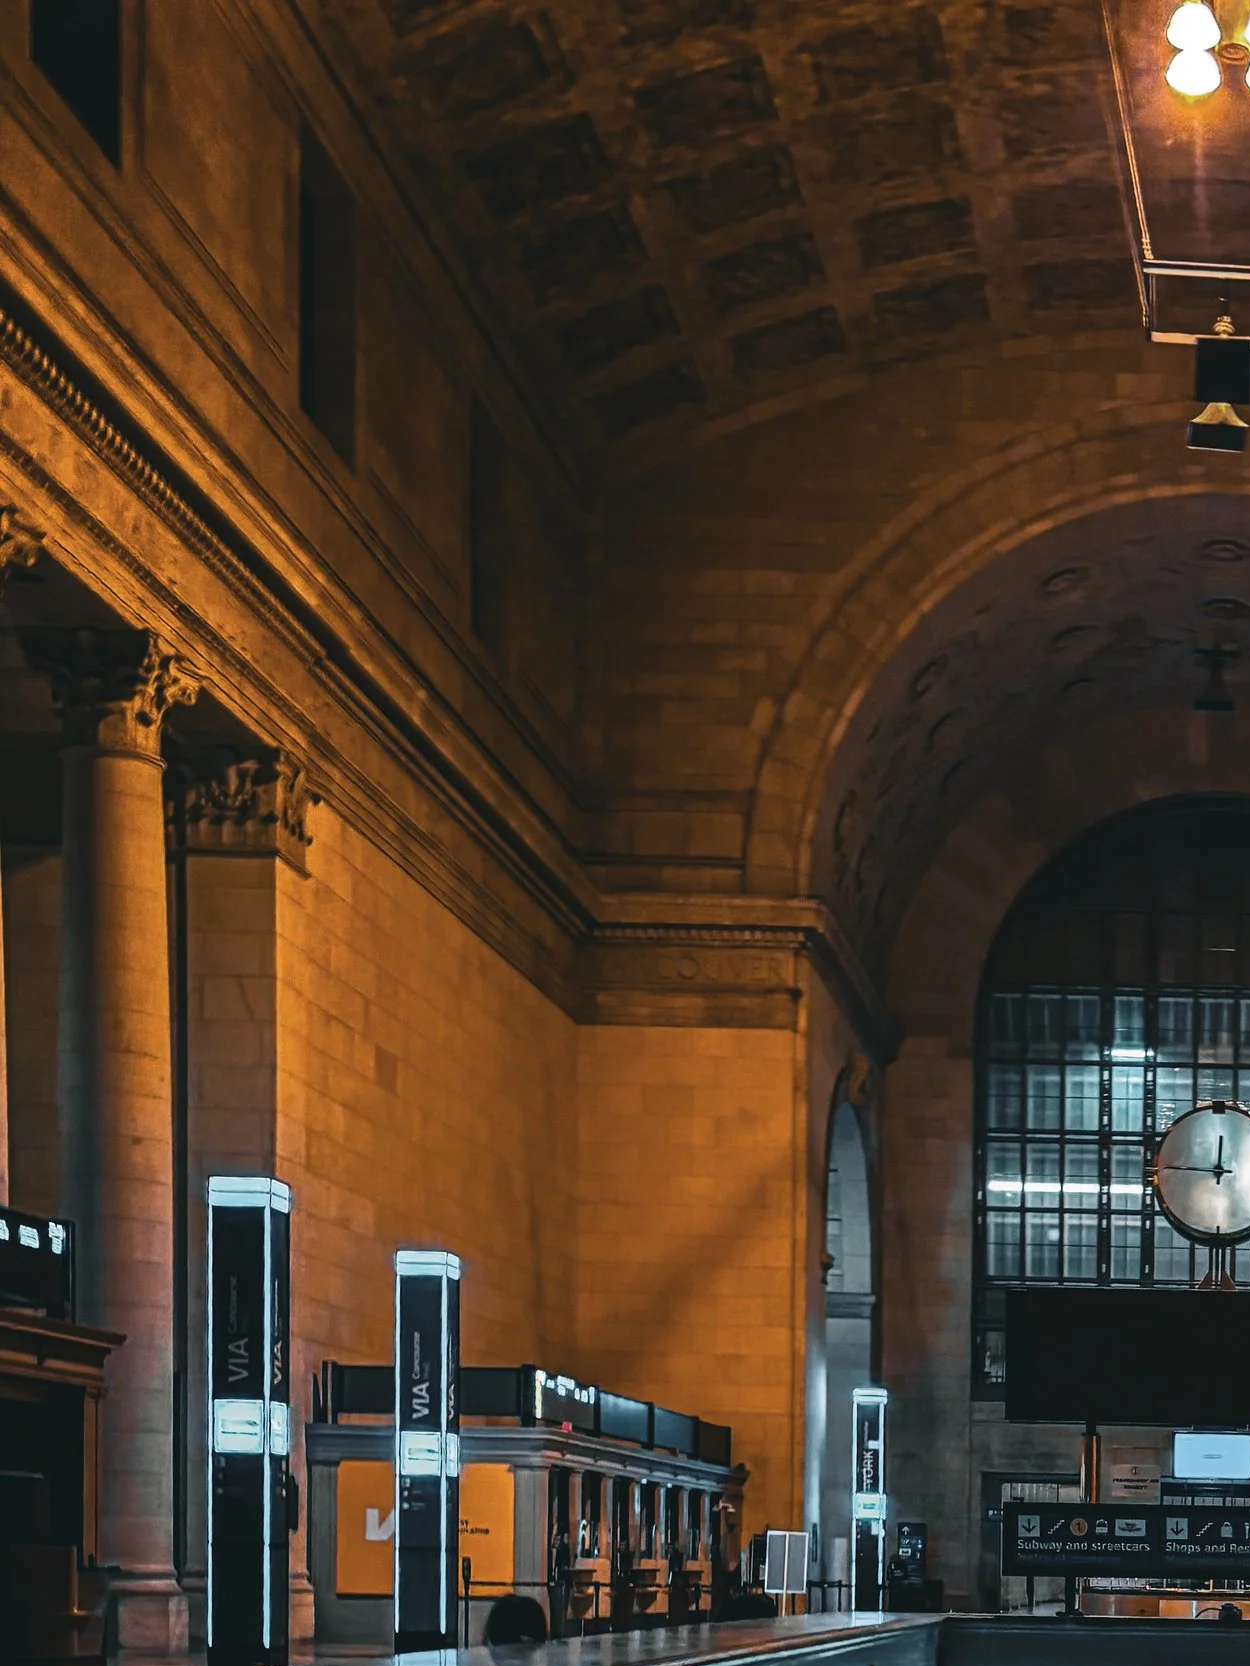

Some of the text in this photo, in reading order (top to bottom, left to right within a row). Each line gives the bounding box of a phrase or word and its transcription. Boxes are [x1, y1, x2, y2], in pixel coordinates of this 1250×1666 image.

[227, 1337, 250, 1383] VIA
[411, 1381, 431, 1420] VIA
[1017, 1539, 1151, 1553] Subway and streetcars
[1165, 1541, 1201, 1555] Shops
[1204, 1543, 1226, 1554] and
